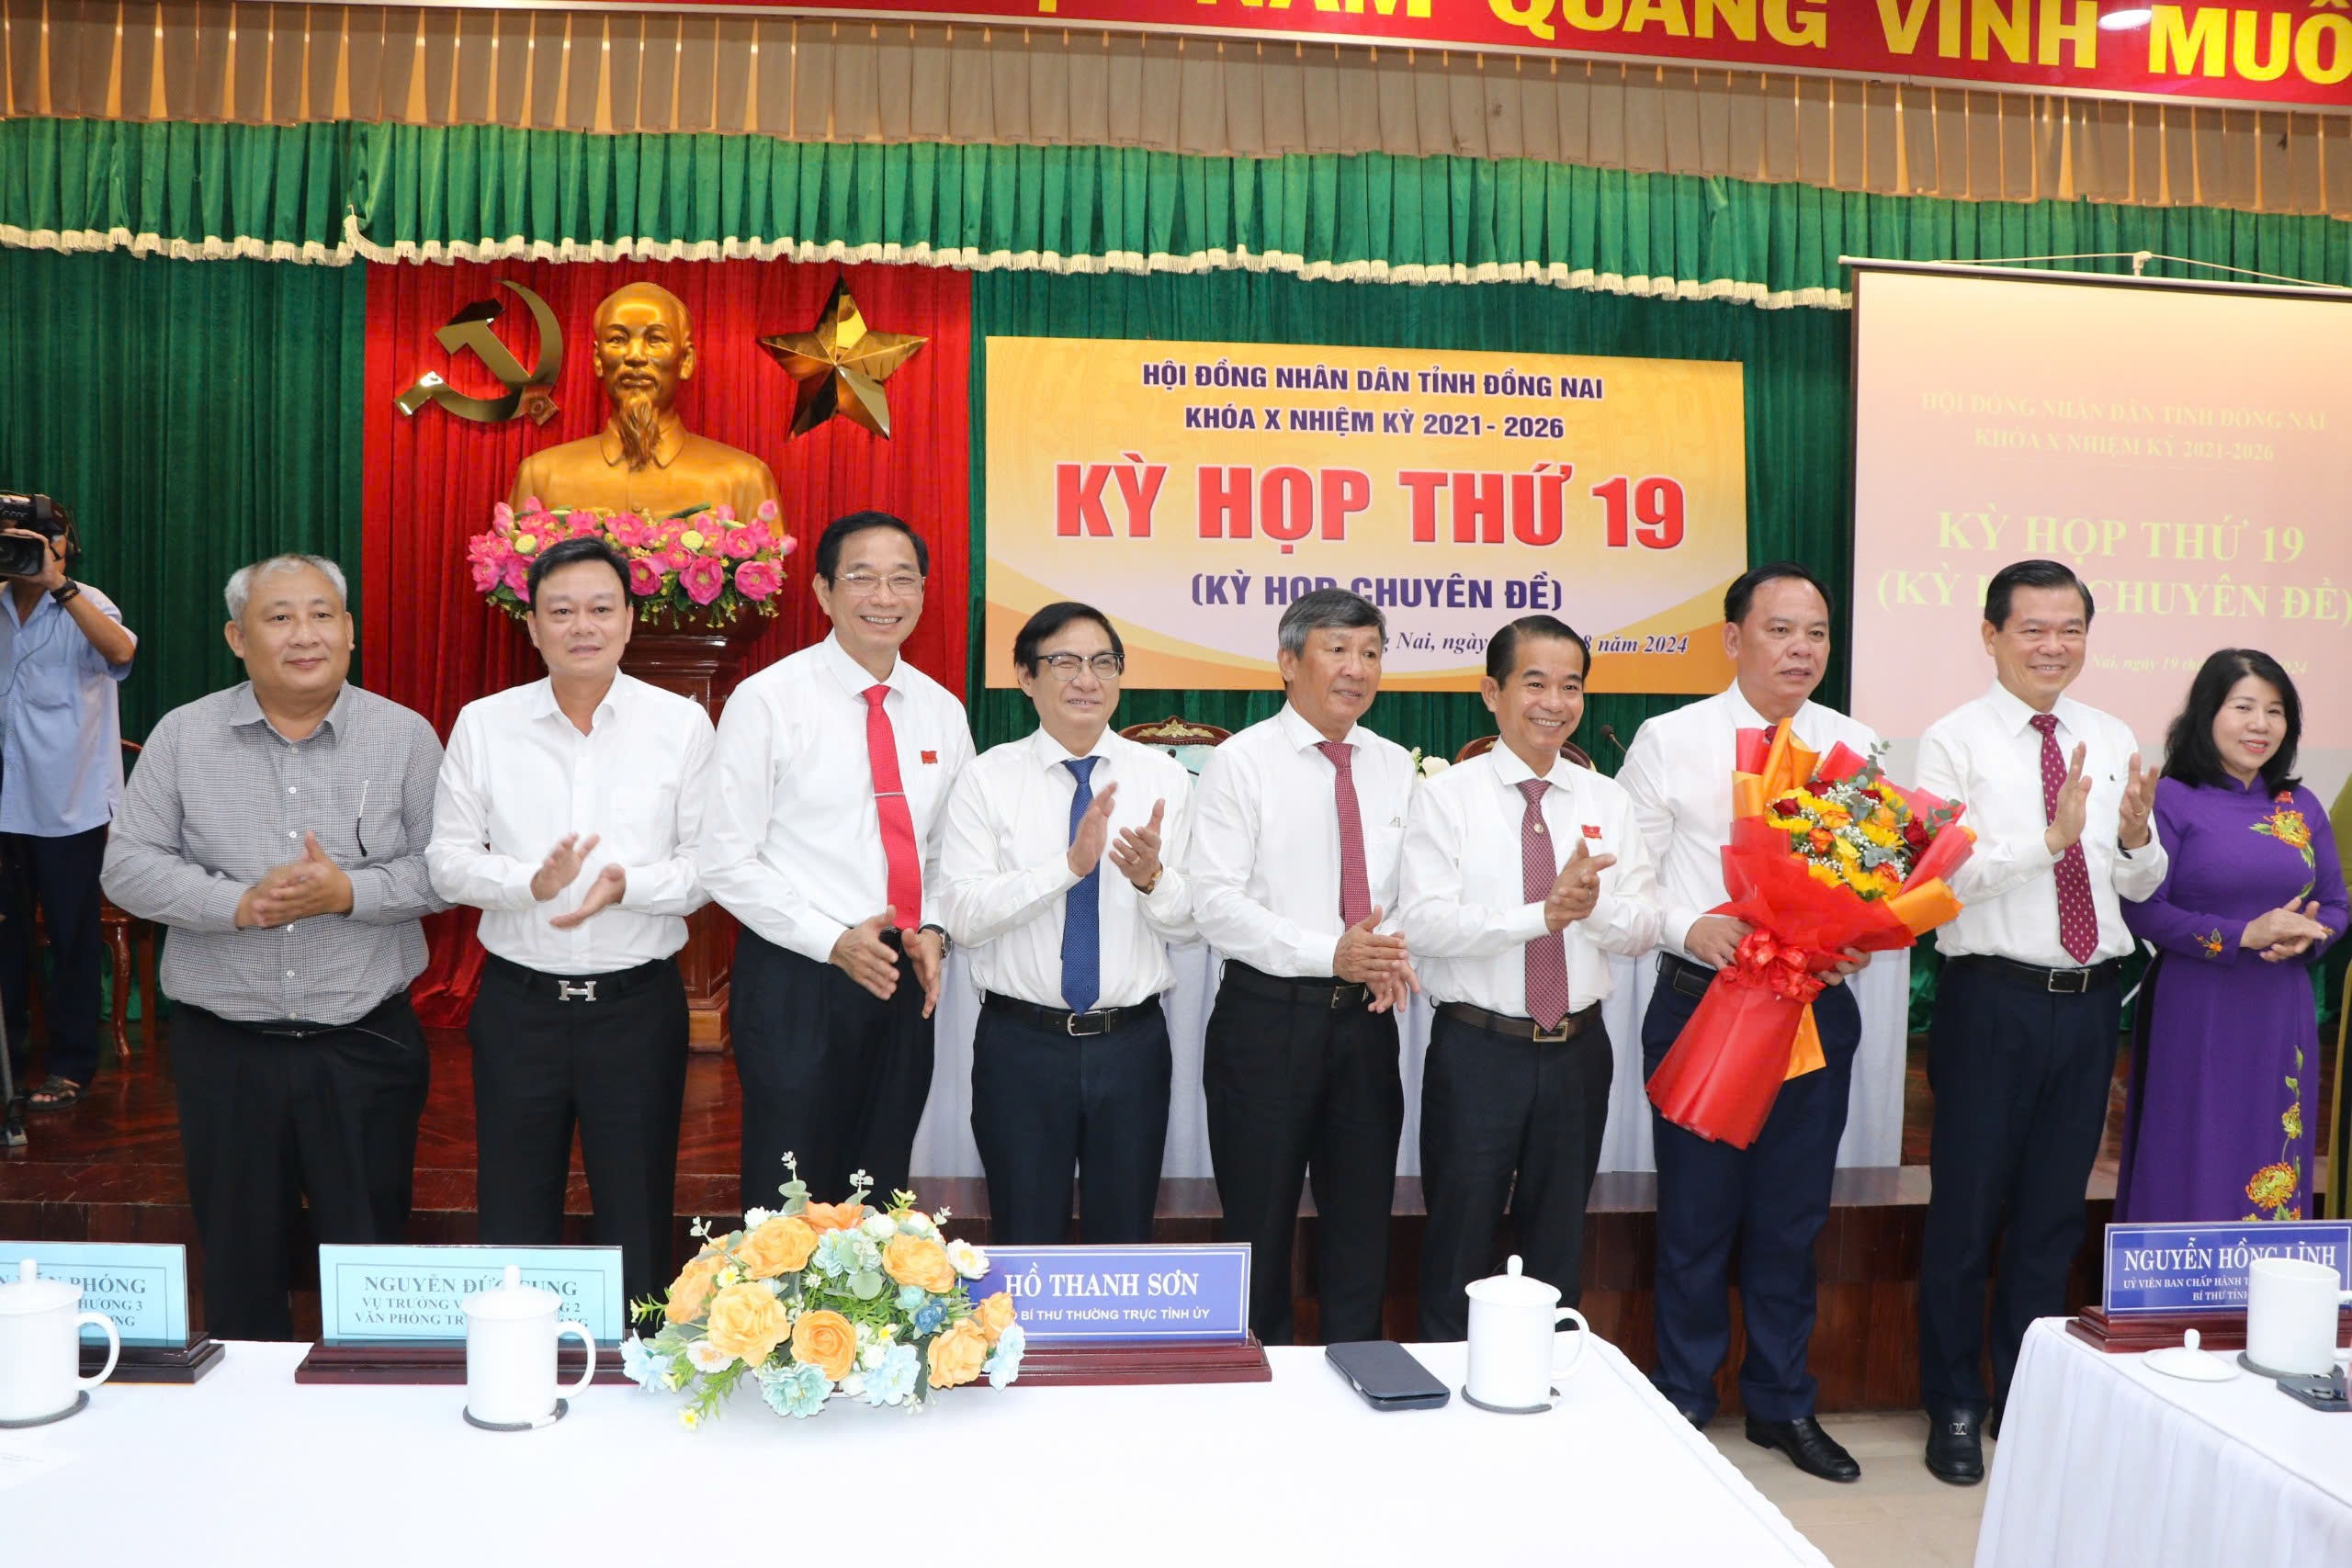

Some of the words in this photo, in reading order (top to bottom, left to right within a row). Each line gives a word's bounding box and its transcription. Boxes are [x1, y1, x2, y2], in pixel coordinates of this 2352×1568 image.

[1876, 0, 2098, 69] VINH
[1143, 359, 1186, 390] HỘI
[1194, 357, 1267, 388] ĐỒNG
[1276, 364, 1349, 390] NHÂN
[1357, 367, 1409, 392] DÂN
[1418, 366, 1476, 394] TỈNH
[1484, 367, 1553, 397] ĐỒNG
[1561, 378, 1603, 399] NAI
[1185, 403, 1256, 429] KHÓA
[1264, 409, 1281, 430] X
[1289, 406, 1374, 436] NHIỆM
[1383, 408, 1415, 434] KỲ
[1504, 416, 1565, 438] 2026
[1056, 452, 1168, 538] KỲ
[1198, 466, 1371, 555] HỌP
[1398, 462, 1573, 547] THỨ
[1591, 477, 1684, 549] 19
[1937, 502, 2010, 551] KỲ
[2024, 514, 2128, 565] HỌP
[2140, 513, 2250, 562] THỨ
[2260, 526, 2305, 563] 19
[1193, 569, 1252, 606] (KỲ
[1351, 572, 1493, 609] CHUYÊN
[1504, 570, 1563, 612] ĐỀ)
[1877, 561, 1962, 613] (KỲ
[2086, 573, 2270, 618] CHUYÊN
[1396, 632, 1435, 652] Nai,
[1442, 633, 1488, 654] ngày
[1599, 635, 1638, 652] năm
[1644, 636, 1687, 654] 2024
[2124, 1236, 2212, 1270] NGUYỄN
[1004, 1262, 1042, 1297] HỒ
[1049, 1273, 1139, 1297] THANH
[1148, 1269, 1199, 1296] SƠN
[2165, 1278, 2184, 1288] BAN
[79, 1299, 131, 1311] HƯƠNG
[136, 1301, 142, 1311] 3
[574, 1303, 581, 1312] 2
[1021, 1308, 1034, 1320] BÍ
[1036, 1309, 1063, 1320] THƯ
[1066, 1308, 1119, 1320] THƯỜNG
[1123, 1308, 1157, 1322] TRỰC
